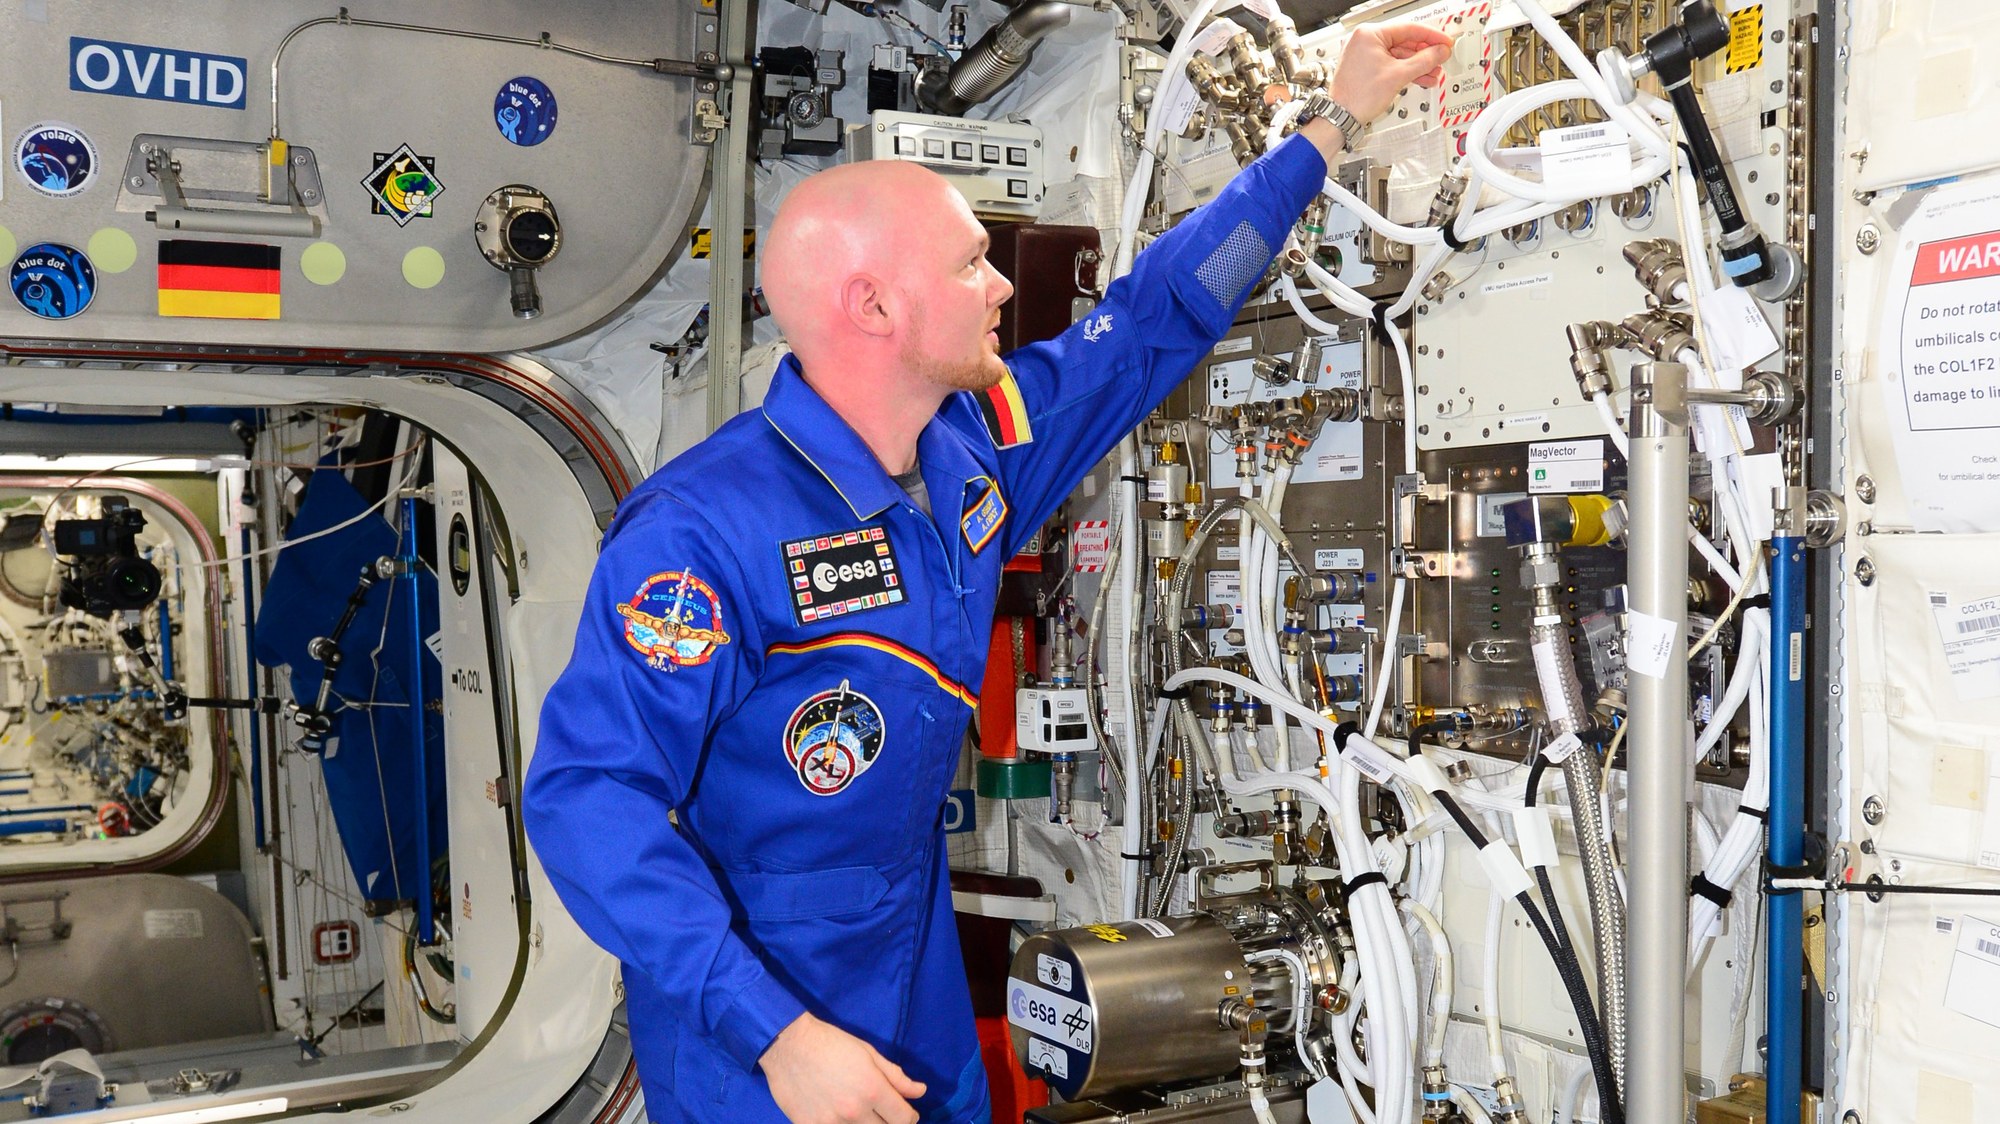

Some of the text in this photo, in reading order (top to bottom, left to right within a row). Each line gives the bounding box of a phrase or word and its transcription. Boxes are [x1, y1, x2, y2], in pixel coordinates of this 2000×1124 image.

[1839, 46, 1846, 58] A
[76, 44, 244, 104] OVHD
[509, 82, 542, 108] blue dot
[1446, 101, 1482, 117] RACK POWE
[40, 130, 76, 144] volare
[1325, 230, 1356, 242] HELIUM OUT
[1938, 241, 2000, 274] WAR
[18, 258, 66, 271] blue dot
[1920, 307, 1938, 320] Do
[1943, 304, 1965, 318] not
[1915, 330, 1985, 348] umbilicals
[1914, 357, 1995, 375] the COL1F2
[1340, 370, 1361, 379] POWER
[1834, 369, 1843, 380] B
[1913, 390, 1967, 404] damage
[1971, 387, 1984, 399] to
[1530, 446, 1577, 459] MagVector
[1971, 455, 1997, 463] Check
[1951, 472, 1985, 480] umbilical
[1079, 543, 1103, 552] BREATHING
[1318, 551, 1338, 559] POWER
[458, 669, 482, 694] To COL
[1830, 684, 1839, 695] C
[1828, 991, 1835, 1002] D
[1077, 1038, 1090, 1052] DLR
